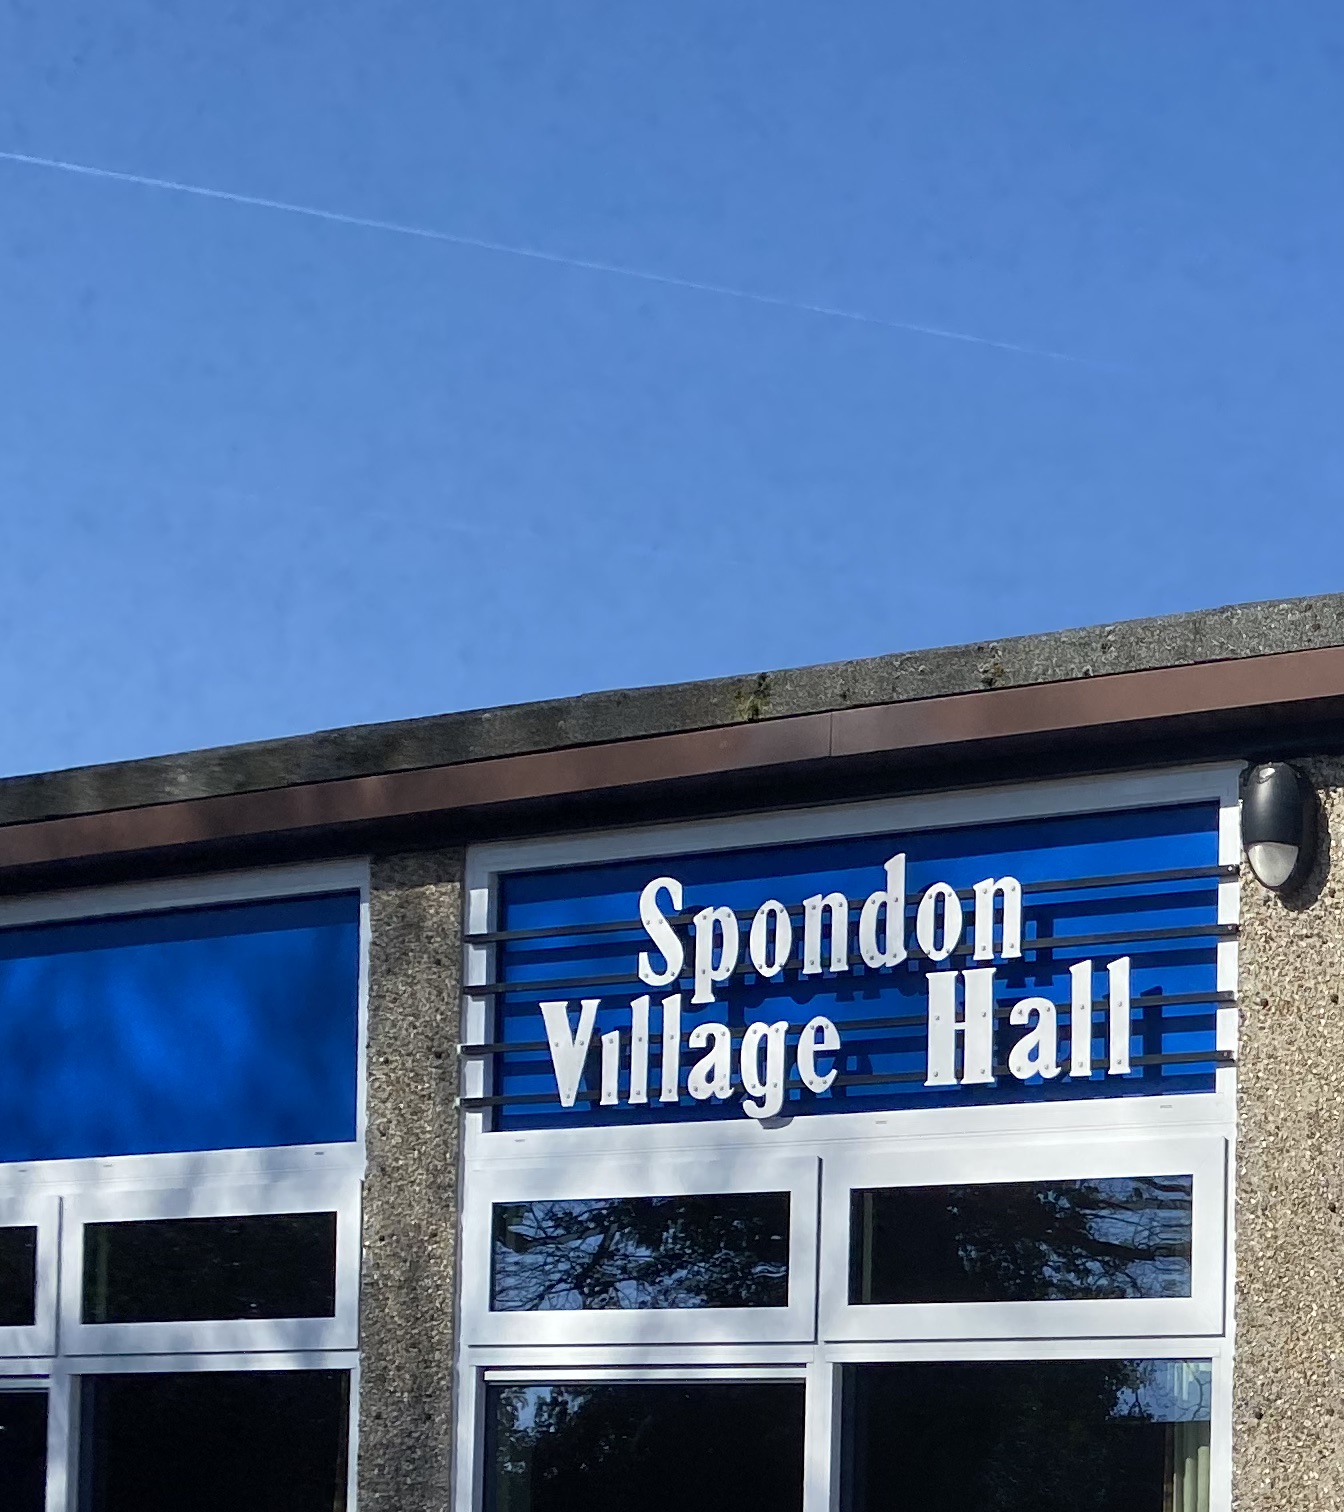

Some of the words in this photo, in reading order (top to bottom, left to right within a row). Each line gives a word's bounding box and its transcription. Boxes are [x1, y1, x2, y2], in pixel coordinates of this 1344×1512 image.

[638, 852, 1023, 1003] Spondon
[538, 993, 842, 1120] Village
[924, 955, 1131, 1088] Hall
